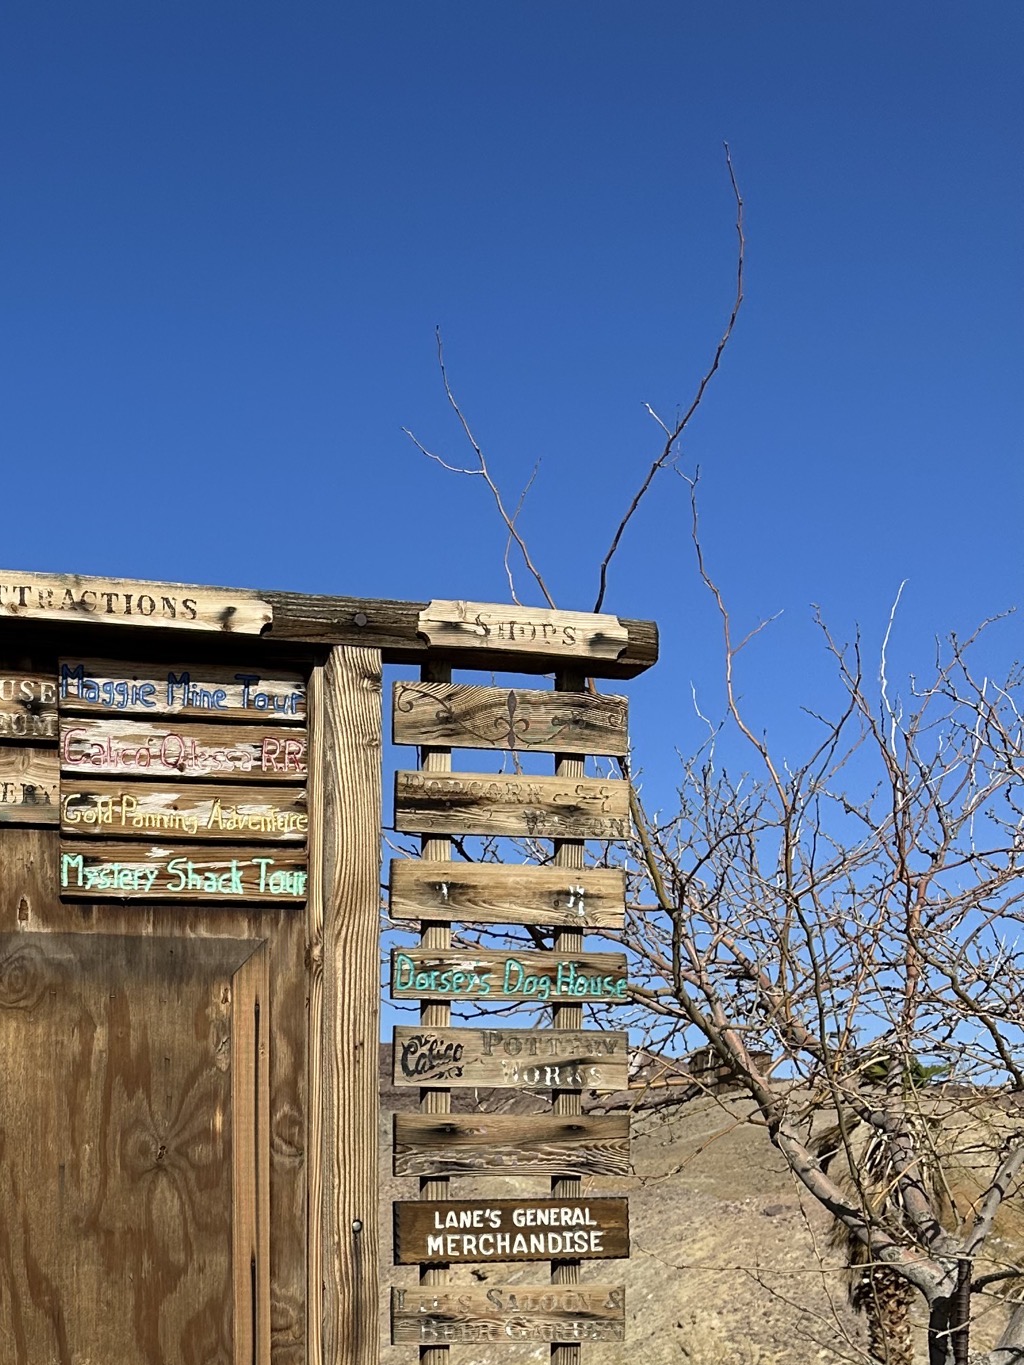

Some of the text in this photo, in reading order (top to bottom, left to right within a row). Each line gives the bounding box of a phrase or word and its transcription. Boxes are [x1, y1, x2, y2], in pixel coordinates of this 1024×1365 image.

[61, 664, 304, 714] Maggie Mine Tour
[63, 727, 152, 768] Calico
[63, 793, 308, 834] Gold Panning Adventure
[61, 854, 308, 896] Mystery Shack Tour
[503, 958, 551, 1000] Dog
[557, 961, 628, 998] House
[400, 1033, 465, 1082] Calico
[434, 1207, 598, 1229] LANE'S GENERAL
[427, 1231, 603, 1256] MERCHANDISE
[604, 1290, 622, 1310] &
